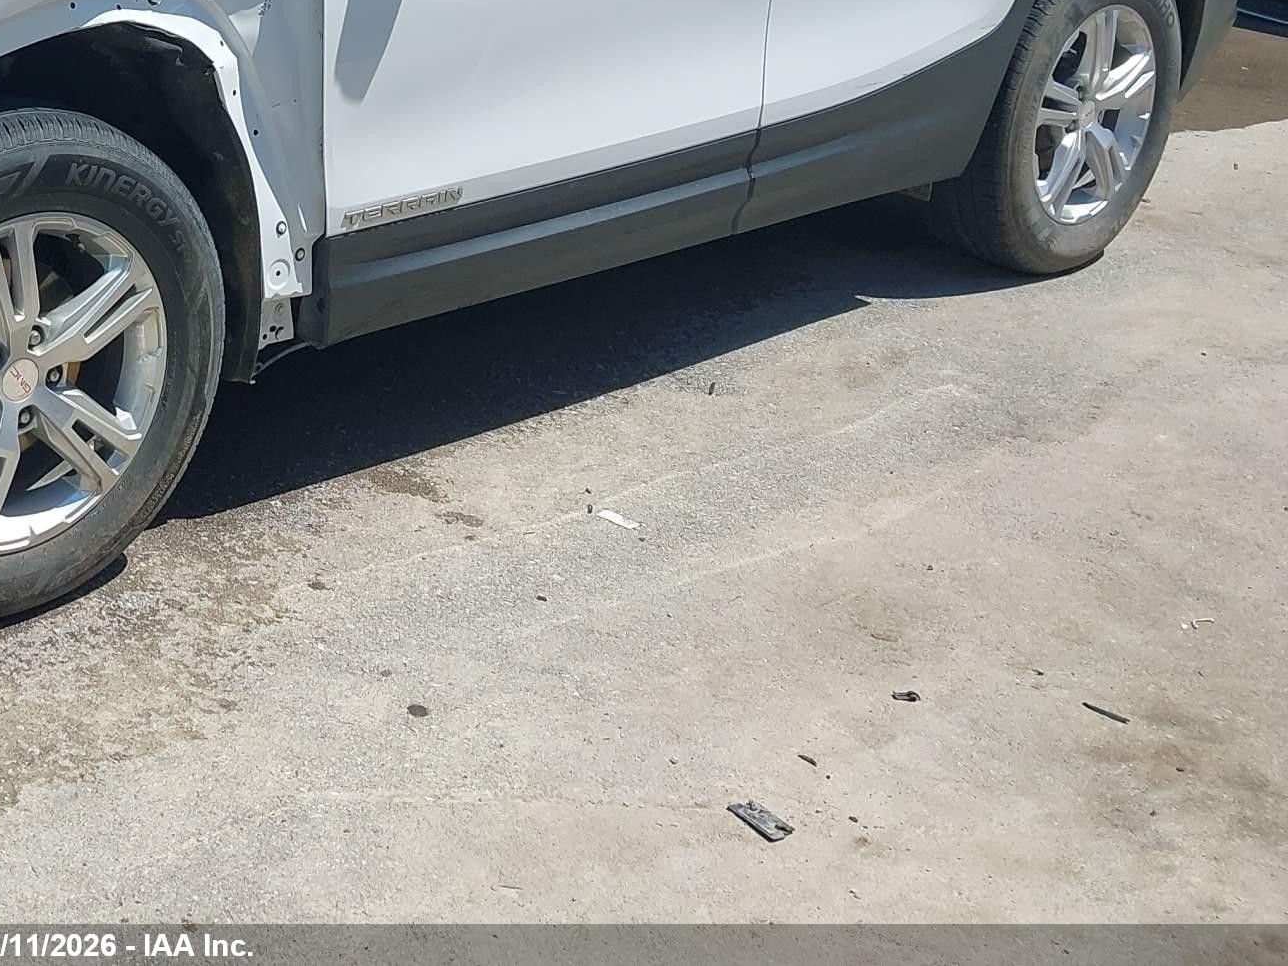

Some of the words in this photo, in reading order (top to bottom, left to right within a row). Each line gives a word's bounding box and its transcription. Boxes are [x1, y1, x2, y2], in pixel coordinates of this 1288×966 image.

[65, 162, 180, 227] KINERGY
[340, 186, 464, 230] TERRAIN
[9, 365, 32, 394] GMC
